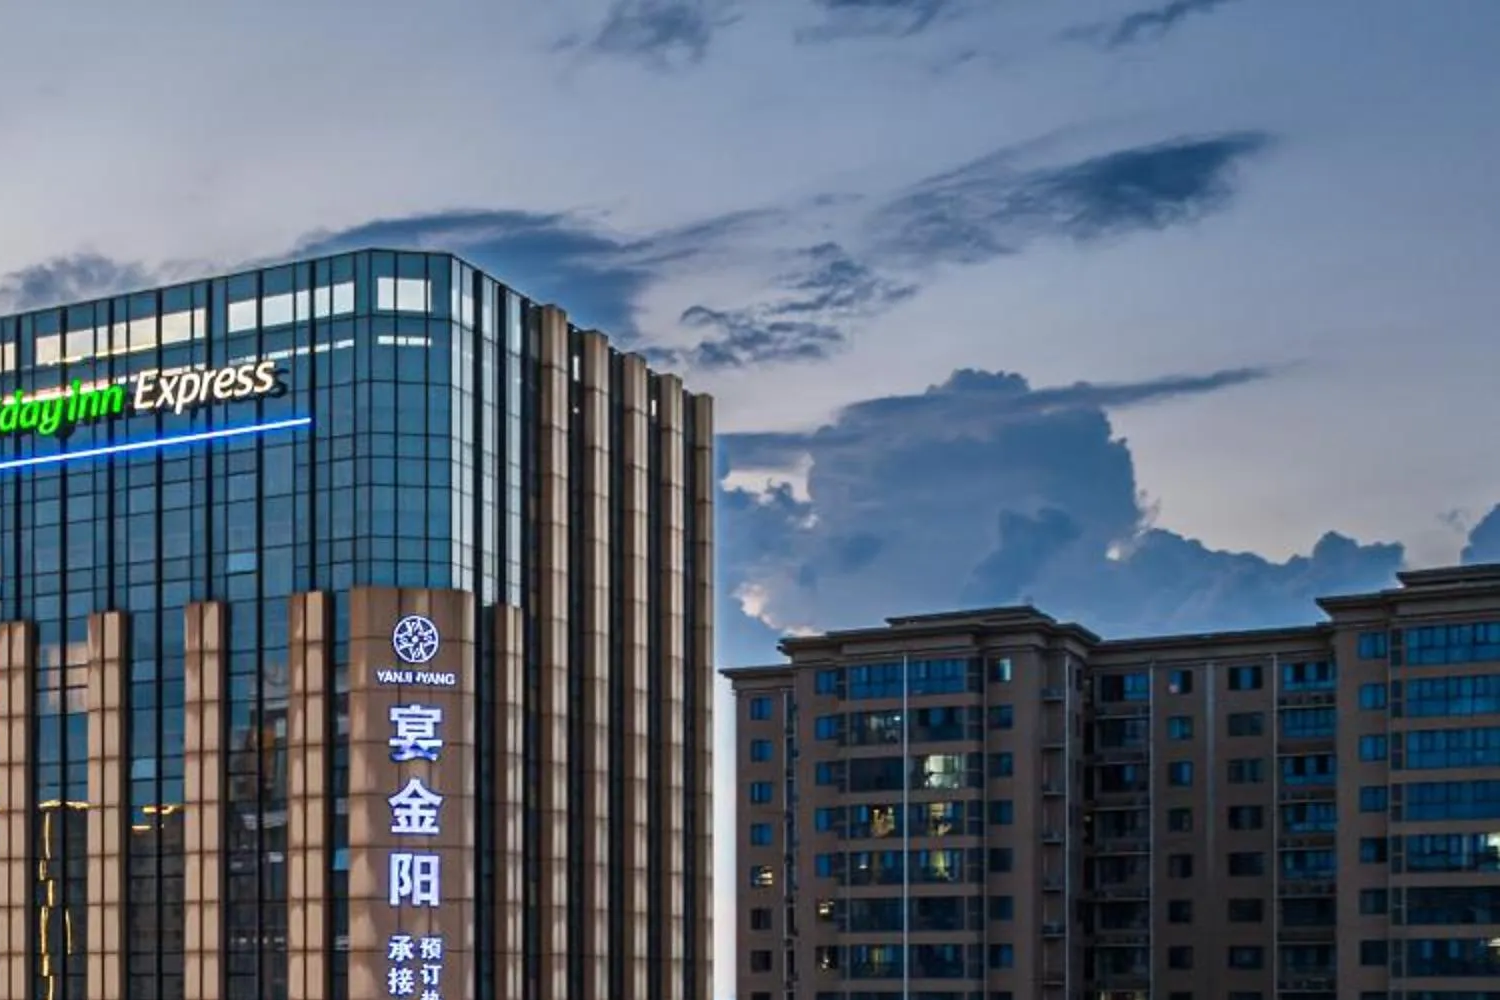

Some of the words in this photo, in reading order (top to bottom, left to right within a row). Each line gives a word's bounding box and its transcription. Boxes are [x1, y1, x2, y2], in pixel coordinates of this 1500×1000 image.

[67, 380, 123, 420] Inn
[134, 360, 276, 414] Express
[388, 704, 443, 907] 宴金阳
